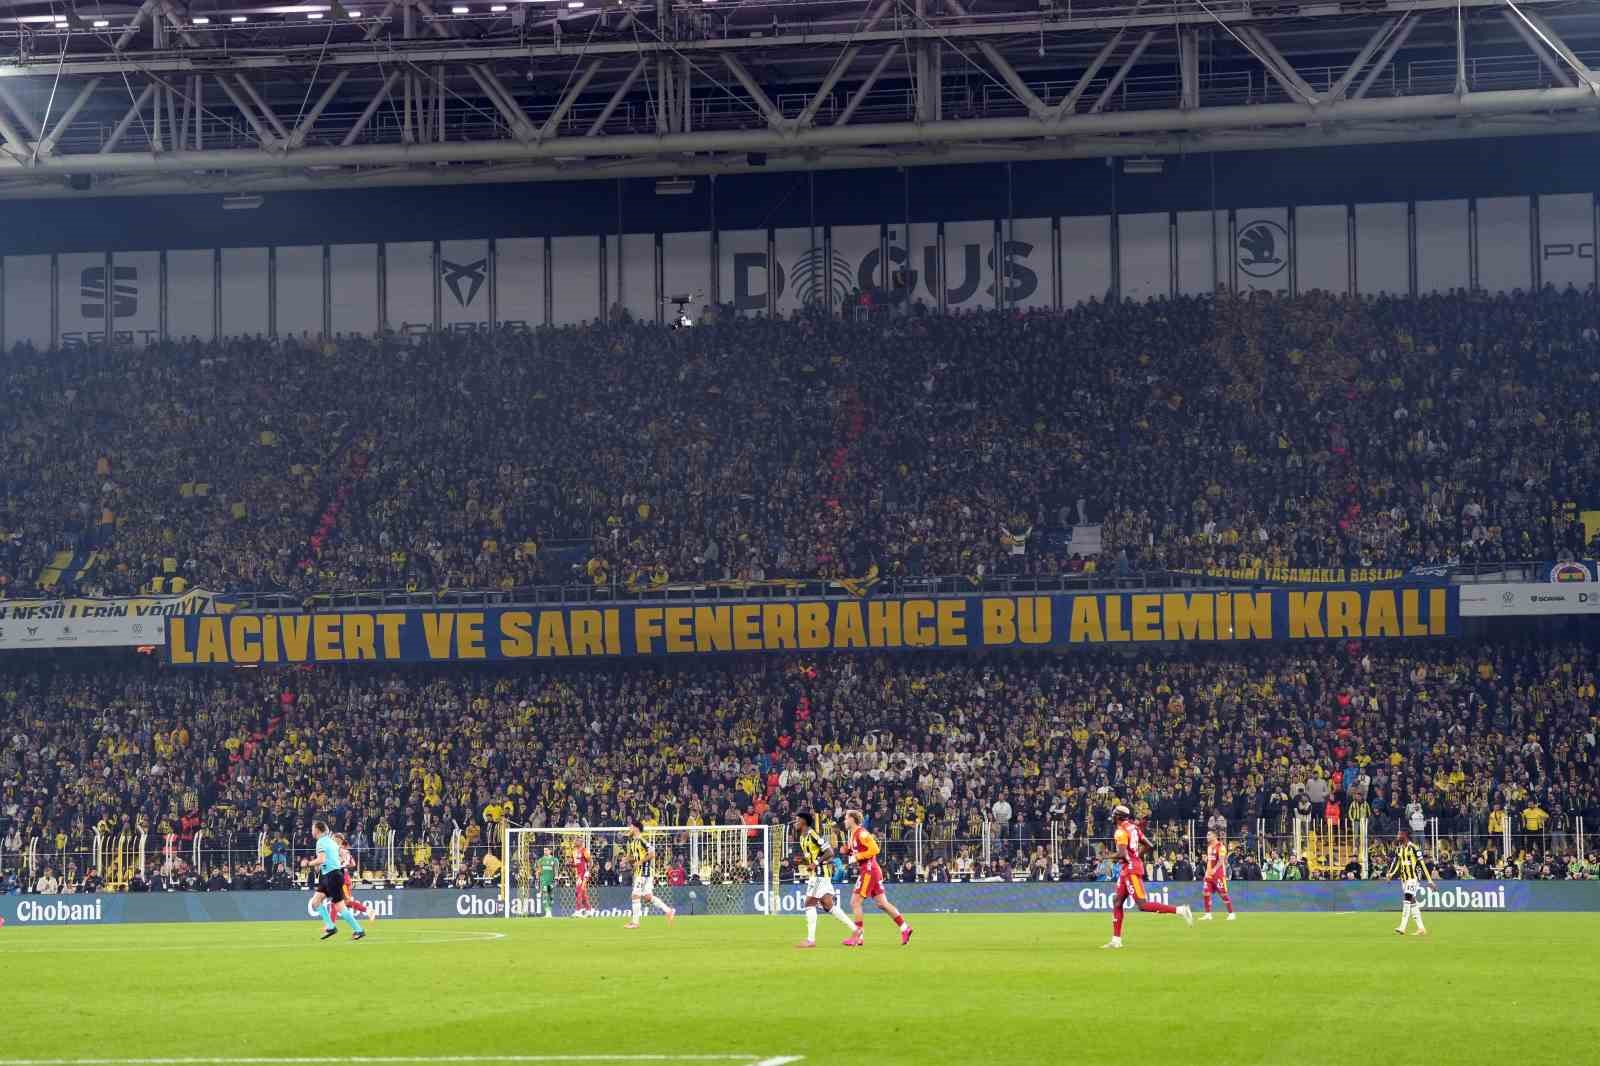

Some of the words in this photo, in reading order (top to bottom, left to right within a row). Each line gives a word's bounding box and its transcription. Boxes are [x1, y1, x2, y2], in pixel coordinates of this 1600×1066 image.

[170, 612, 407, 664] LACİVERT
[421, 612, 487, 660] VE
[500, 607, 621, 658] SARI
[982, 596, 1052, 645] BU
[1069, 590, 1273, 644] ALEMİN
[1288, 588, 1447, 640] KRALI
[753, 889, 841, 911] Cobi
[1078, 886, 1169, 909] Chbni
[1413, 885, 1506, 908] Chobani
[16, 898, 102, 921] Chobani
